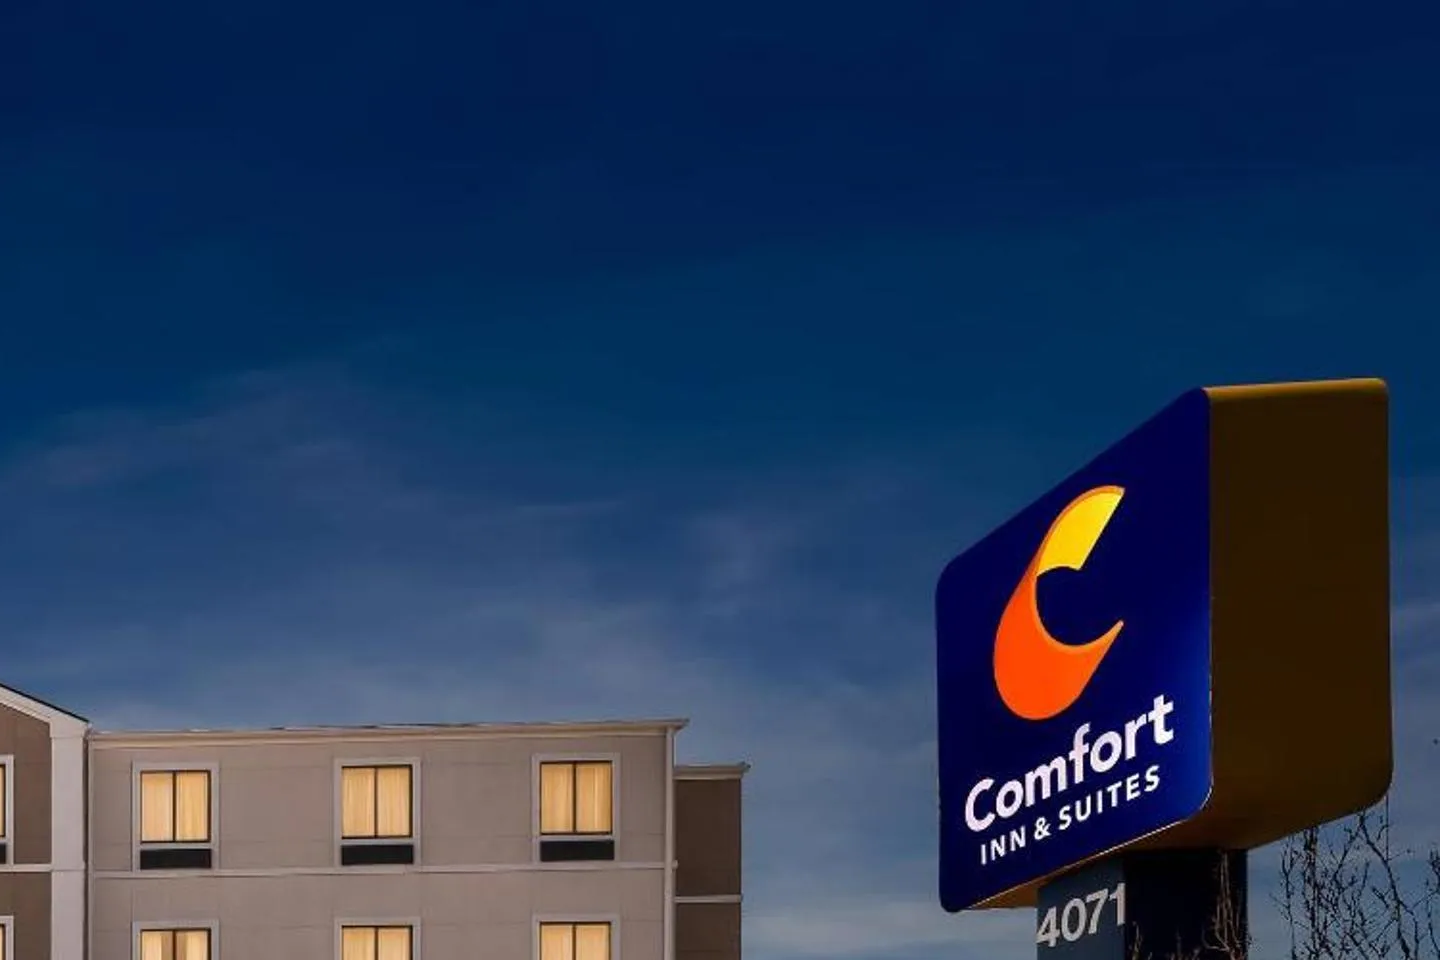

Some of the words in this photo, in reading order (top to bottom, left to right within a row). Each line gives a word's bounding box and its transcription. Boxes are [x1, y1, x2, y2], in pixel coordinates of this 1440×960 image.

[964, 694, 1174, 832] Comfort
[980, 825, 1026, 865] INN
[1034, 816, 1051, 840] &
[1058, 764, 1160, 830] SUITES
[1035, 882, 1126, 947] 4071
